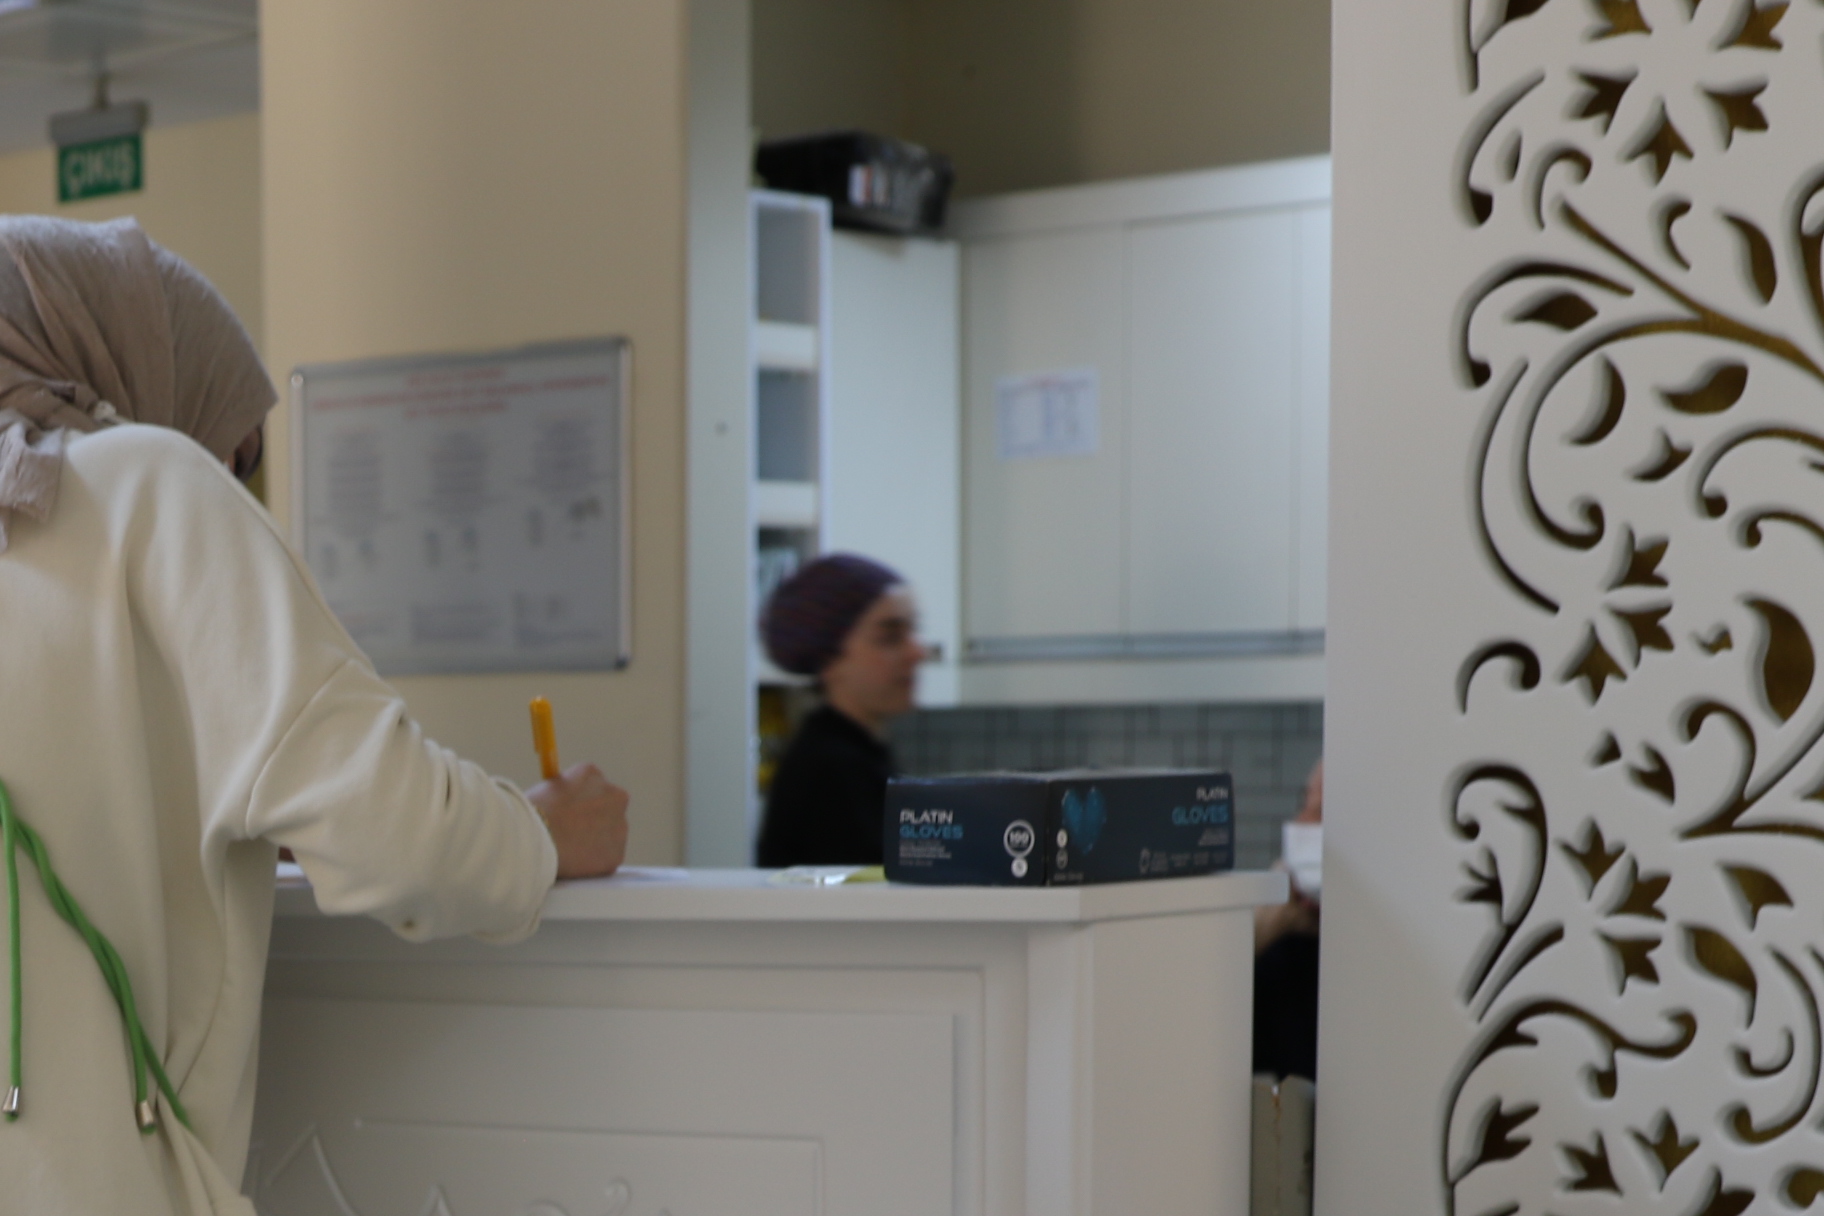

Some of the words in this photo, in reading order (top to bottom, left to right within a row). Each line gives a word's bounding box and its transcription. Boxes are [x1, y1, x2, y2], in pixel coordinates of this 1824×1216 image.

[62, 143, 136, 196] ÇIKIŞ
[1195, 786, 1229, 802] PLATIN
[899, 808, 954, 825] PLATIN
[1171, 804, 1229, 826] GLOVES
[899, 825, 964, 840] GLOVES
